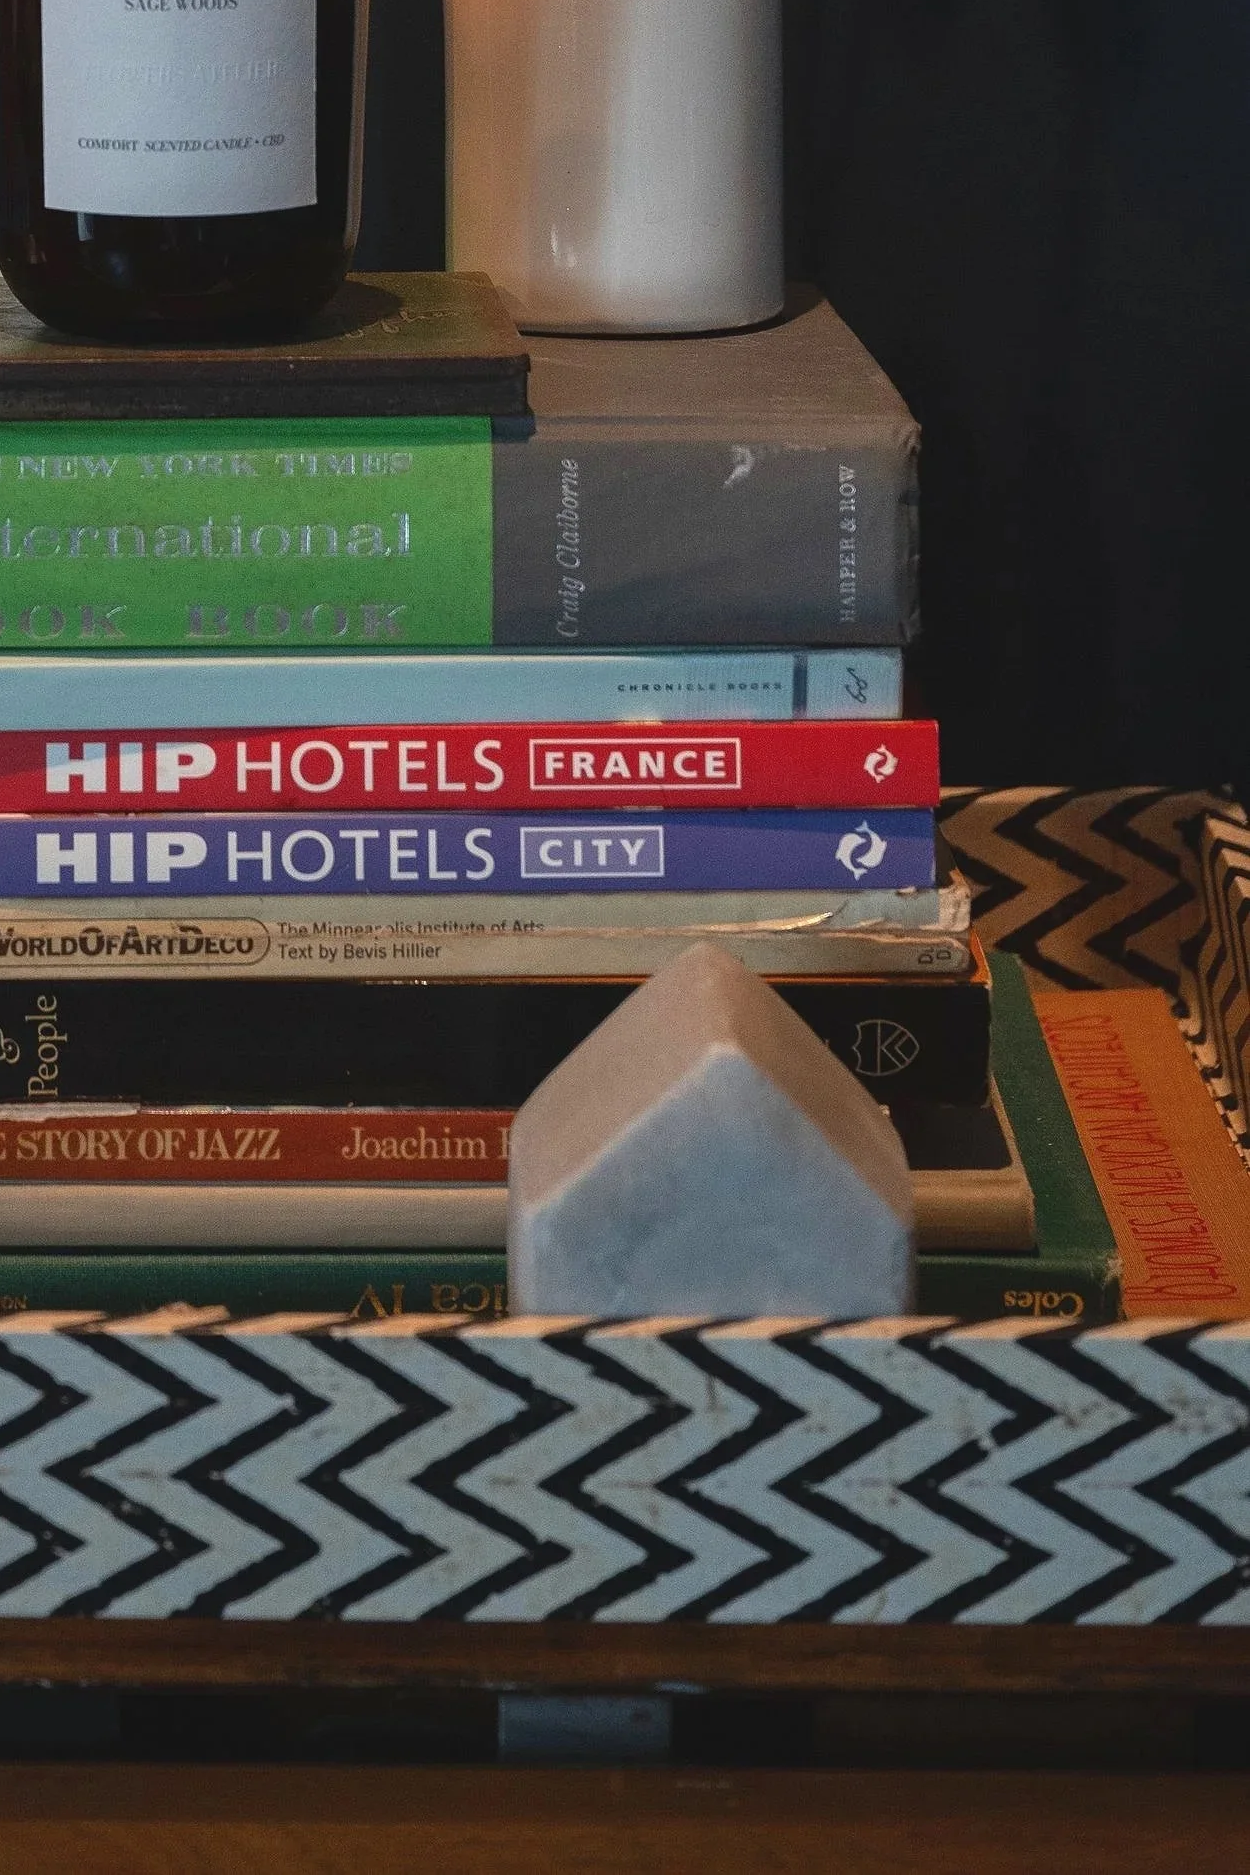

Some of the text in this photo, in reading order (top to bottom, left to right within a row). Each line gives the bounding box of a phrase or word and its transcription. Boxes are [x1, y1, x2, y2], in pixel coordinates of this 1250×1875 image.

[78, 137, 138, 152] COMFORT
[144, 138, 202, 152] SCENTED
[203, 137, 253, 151] CANDLE
[262, 134, 285, 148] CBD
[18, 453, 119, 480] NEW
[139, 452, 259, 479] YORK
[274, 451, 414, 477] TIMES
[555, 458, 586, 638] Craig Claiborne
[838, 464, 857, 624] HARPER & ROW
[183, 601, 408, 641] BOOK
[617, 681, 782, 692] CHRONICLE BOOKS
[45, 741, 218, 794] HIP
[236, 739, 505, 794] HOTELS
[545, 750, 727, 780] FRANCE
[36, 831, 209, 884] HIP
[226, 828, 496, 883] HOTELS
[538, 838, 648, 867] CITY
[278, 922, 309, 937] The
[278, 942, 442, 963] Text by Bevis Hillier
[24, 993, 68, 1099] People
[16, 1127, 135, 1161] STORY
[137, 1127, 183, 1161] OF
[188, 1127, 282, 1161] JAZZ
[341, 1125, 489, 1160] Joachim
[1004, 1289, 1085, 1320] Coles
